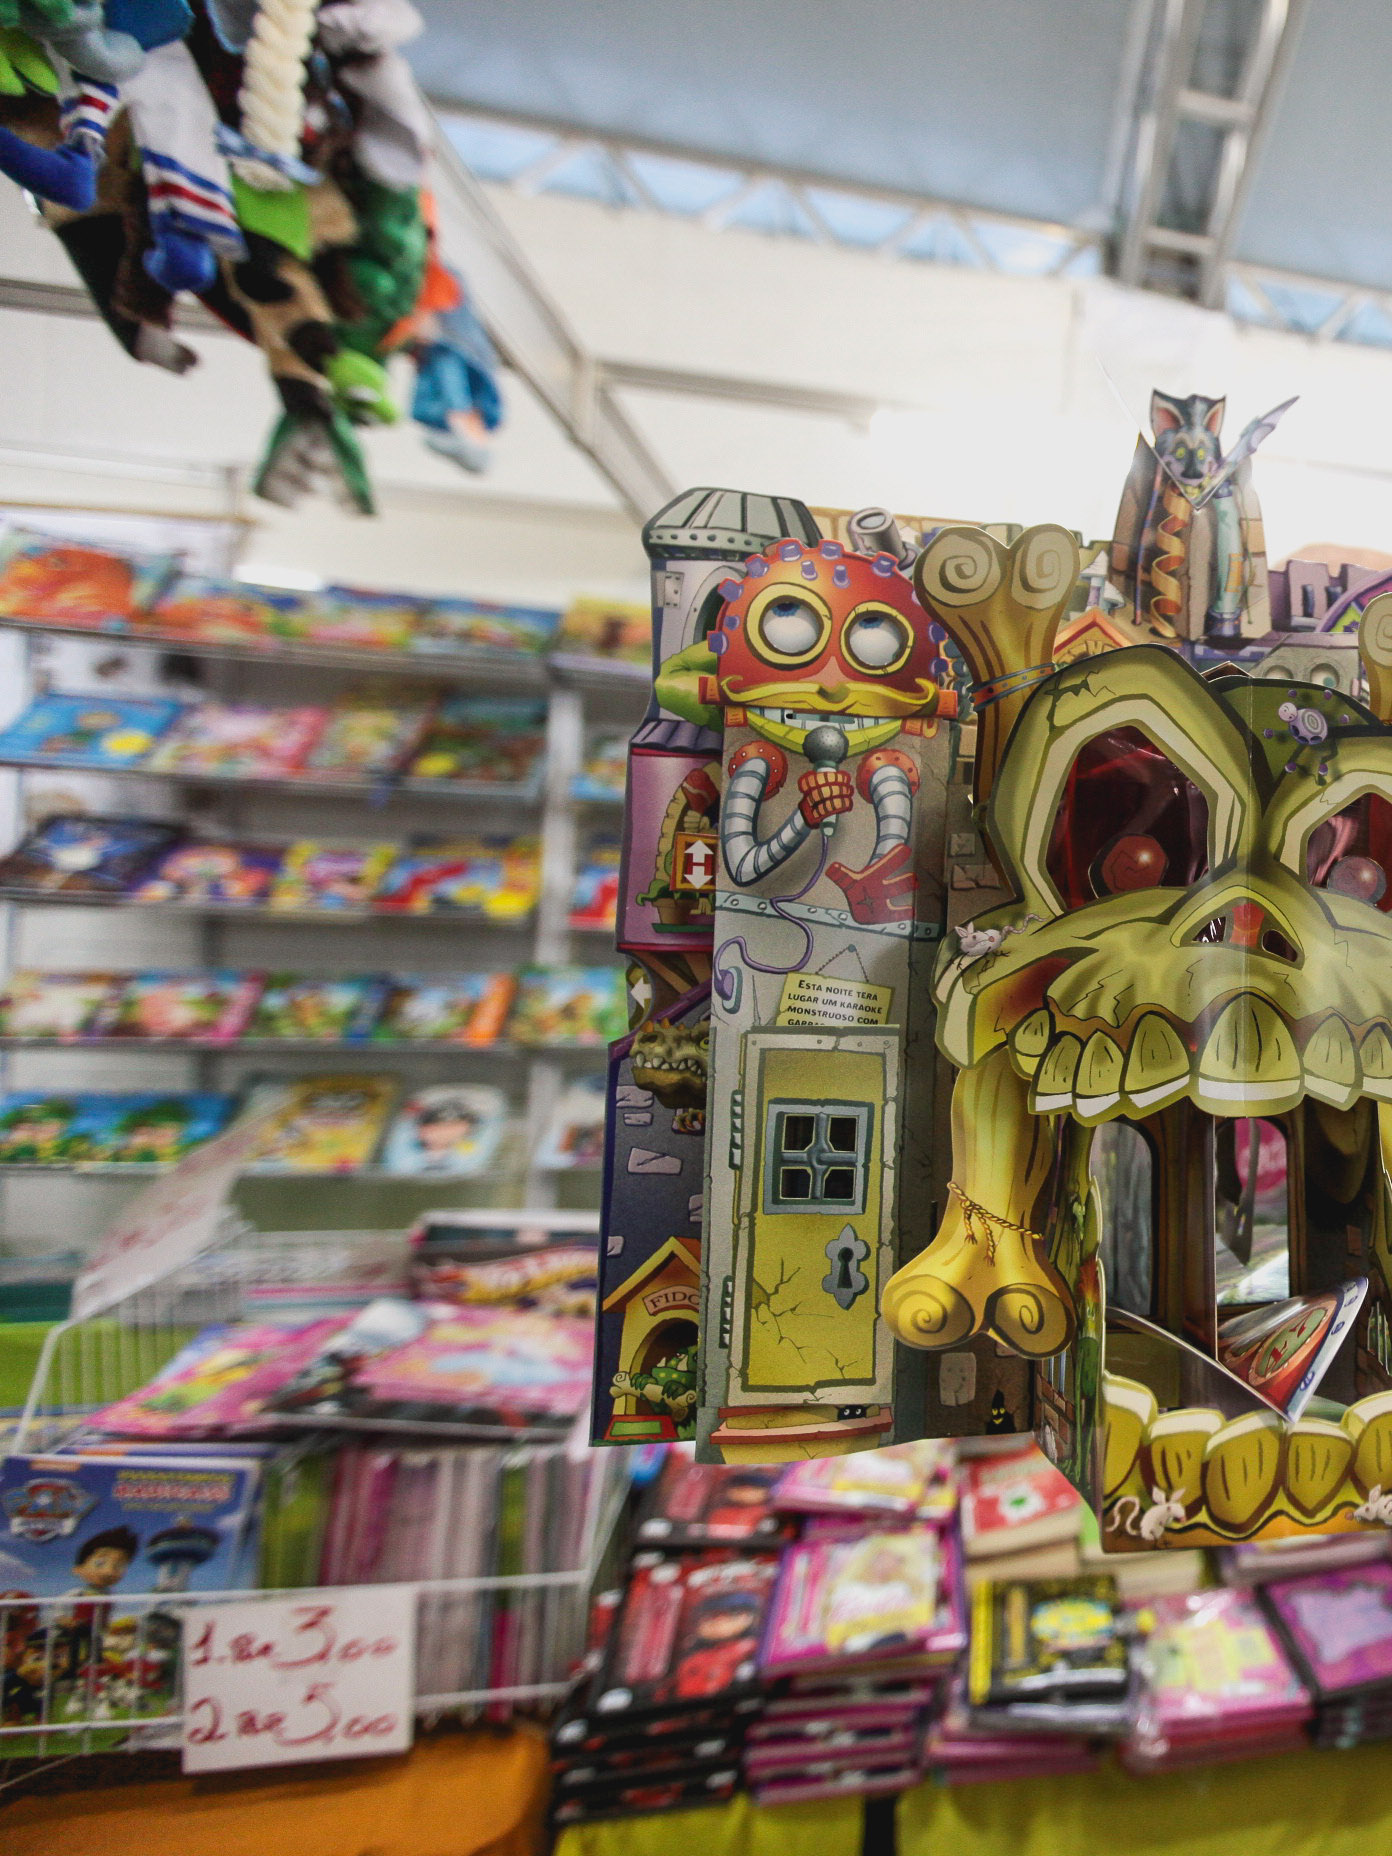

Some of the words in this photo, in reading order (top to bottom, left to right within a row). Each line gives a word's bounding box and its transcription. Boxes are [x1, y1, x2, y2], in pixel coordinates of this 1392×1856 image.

[798, 980, 822, 991] ESTA
[825, 987, 853, 997] NOITE
[788, 993, 819, 1004] LUGAR
[822, 998, 837, 1006] UM
[787, 1005, 854, 1022] MONSTRUOSO
[857, 1016, 879, 1025] COM
